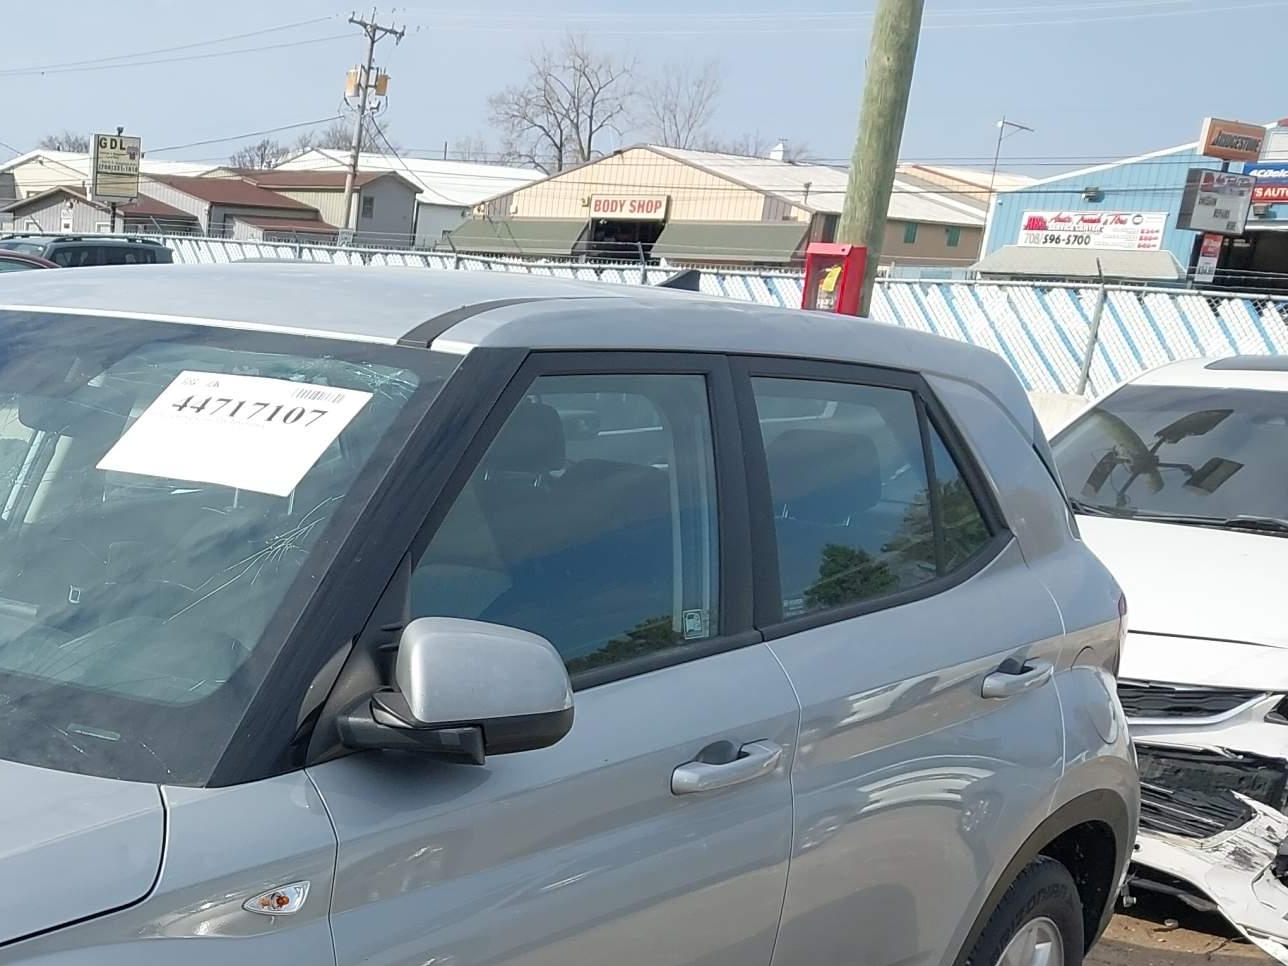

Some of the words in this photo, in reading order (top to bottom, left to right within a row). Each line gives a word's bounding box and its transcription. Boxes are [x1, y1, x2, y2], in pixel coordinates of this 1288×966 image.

[99, 137, 126, 150] GDL
[593, 199, 627, 213] BODY
[629, 200, 663, 214] SHOP
[171, 395, 329, 428] 44717107
